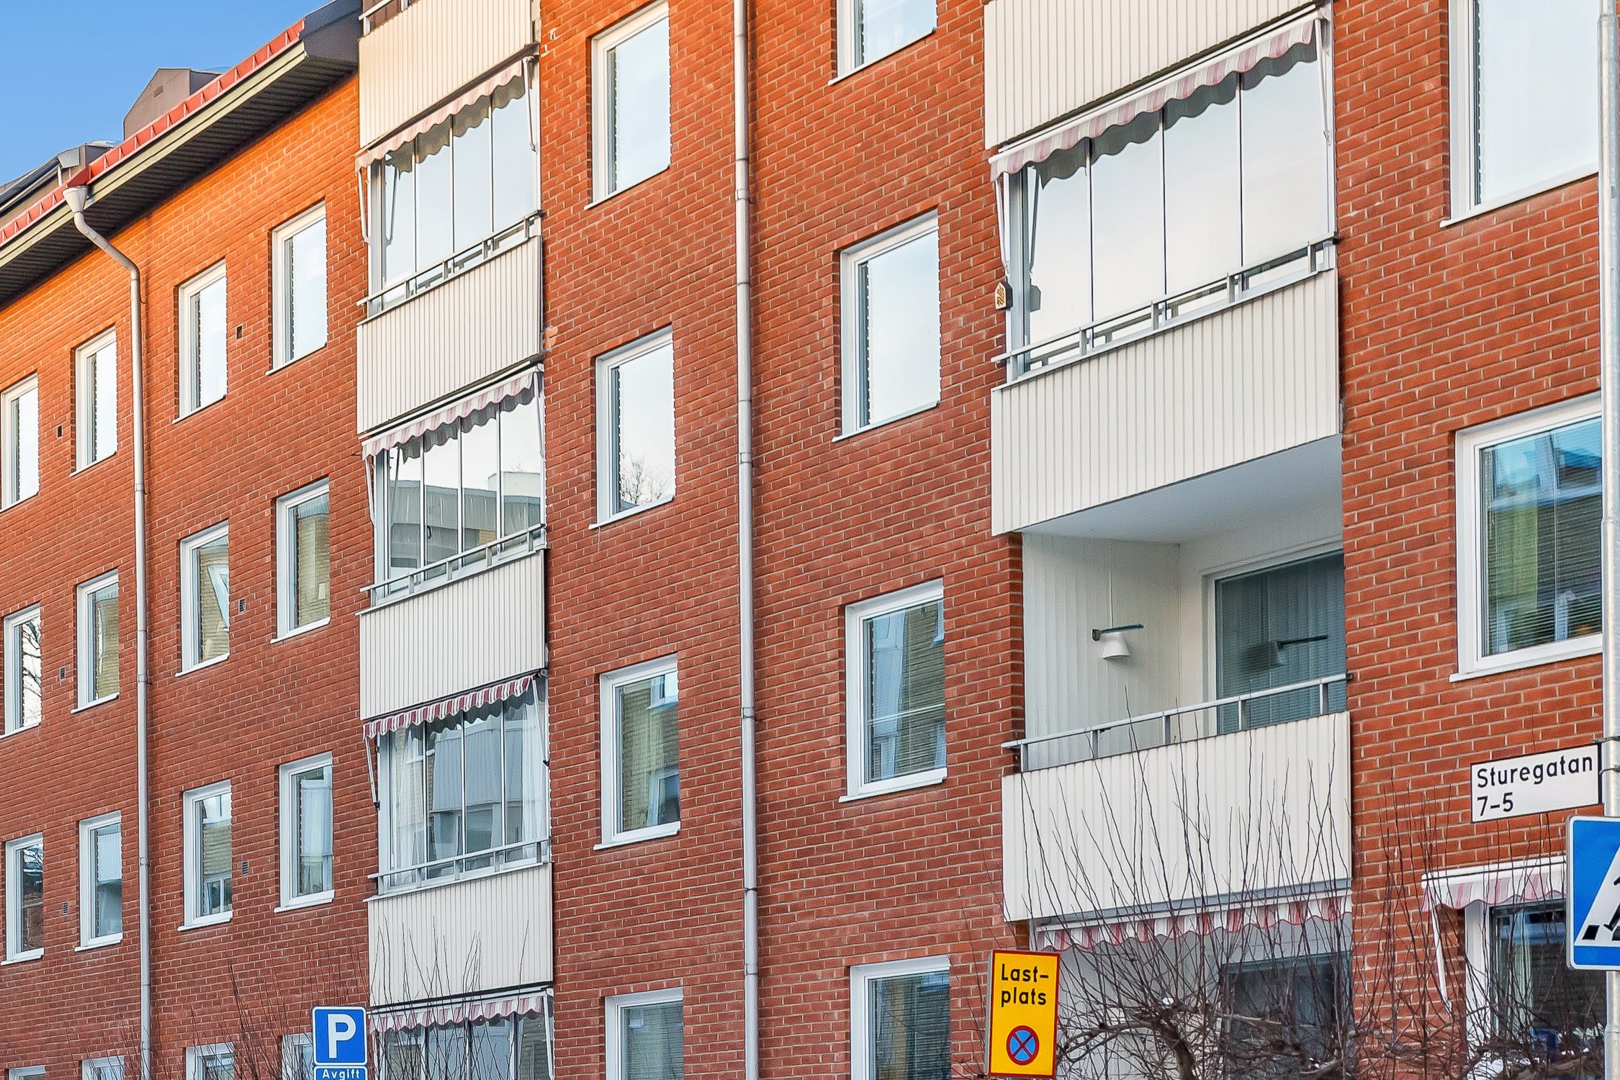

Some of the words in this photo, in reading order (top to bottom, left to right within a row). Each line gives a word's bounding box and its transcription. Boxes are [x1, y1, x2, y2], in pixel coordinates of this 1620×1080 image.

[1476, 755, 1593, 789] Sturegatan
[1476, 791, 1514, 817] 7-5
[1000, 963, 1049, 983] Last-
[1000, 986, 1047, 1008] plats
[327, 1013, 357, 1059] P
[321, 1068, 360, 1080] Avgift
